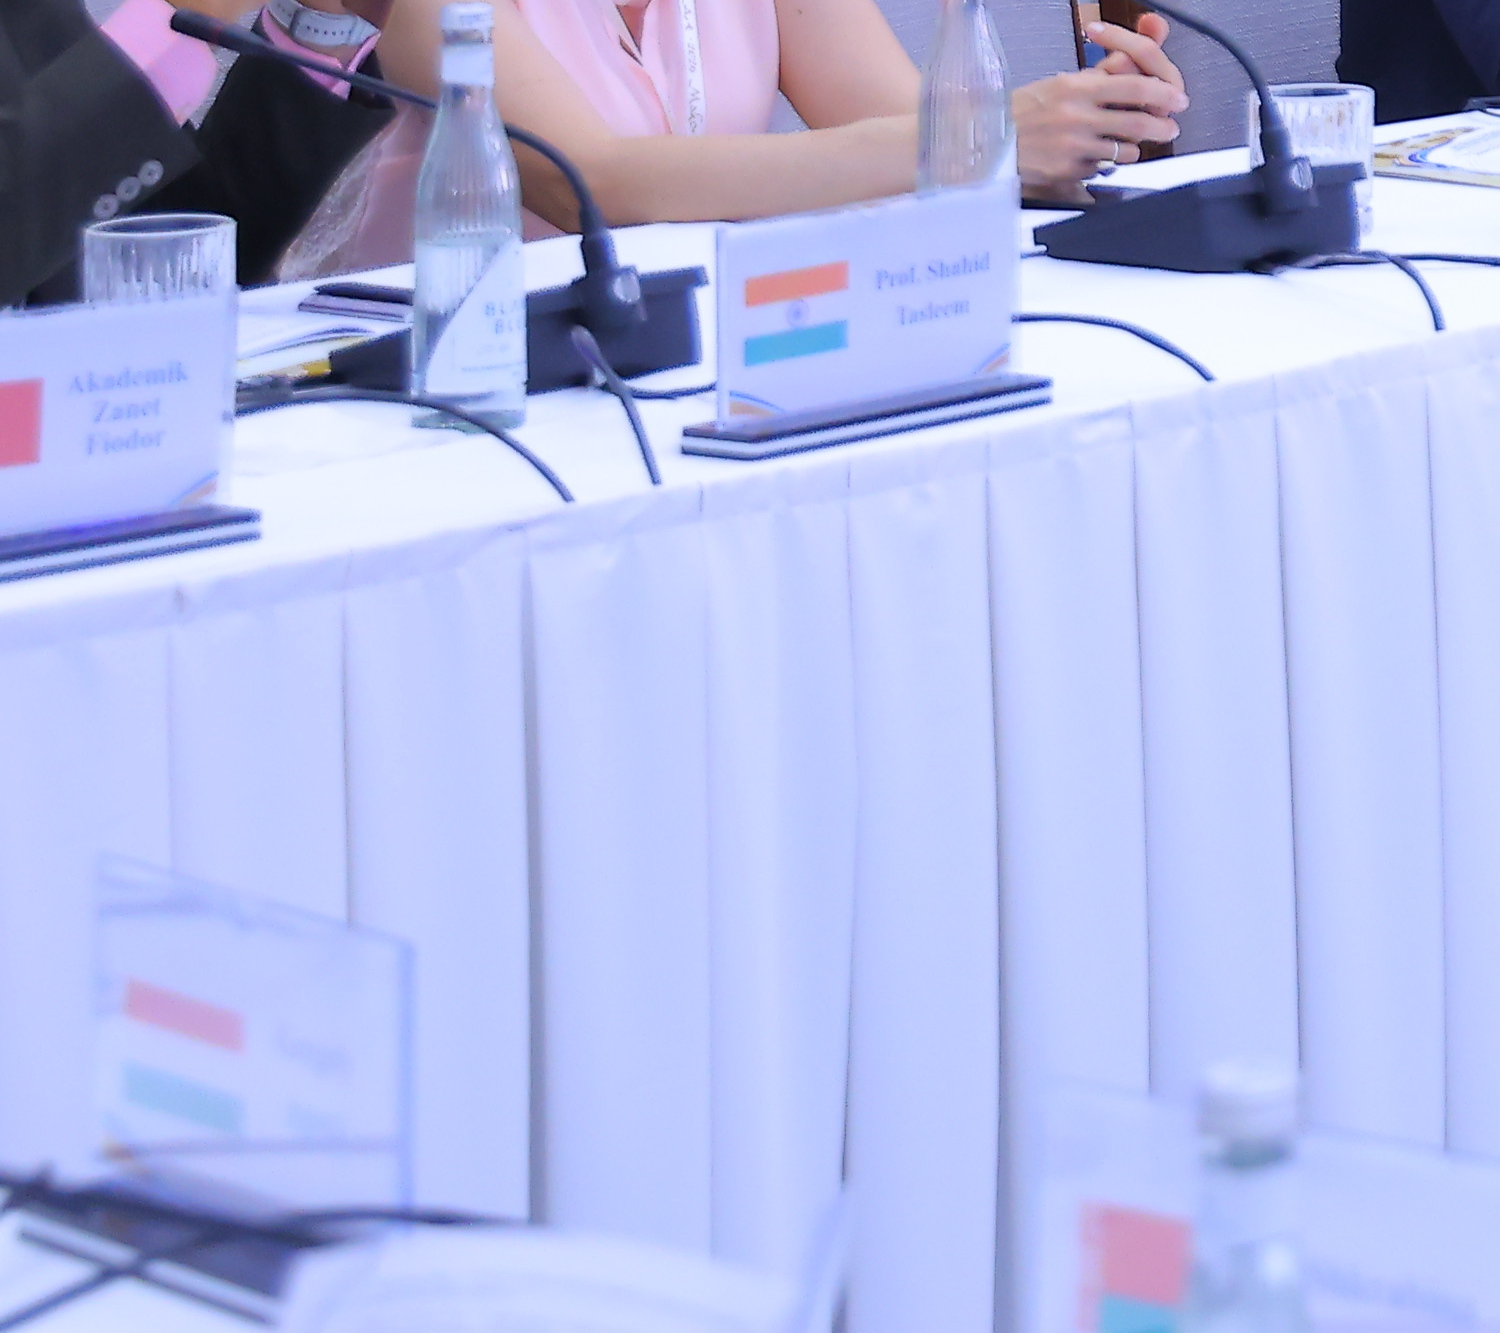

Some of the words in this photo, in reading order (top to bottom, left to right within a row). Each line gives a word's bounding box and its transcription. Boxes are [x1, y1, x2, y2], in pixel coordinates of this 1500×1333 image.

[926, 251, 990, 282] Shahid
[897, 299, 971, 326] Tasleem
[68, 360, 189, 394] Akademik
[85, 429, 167, 456] Fiodor
